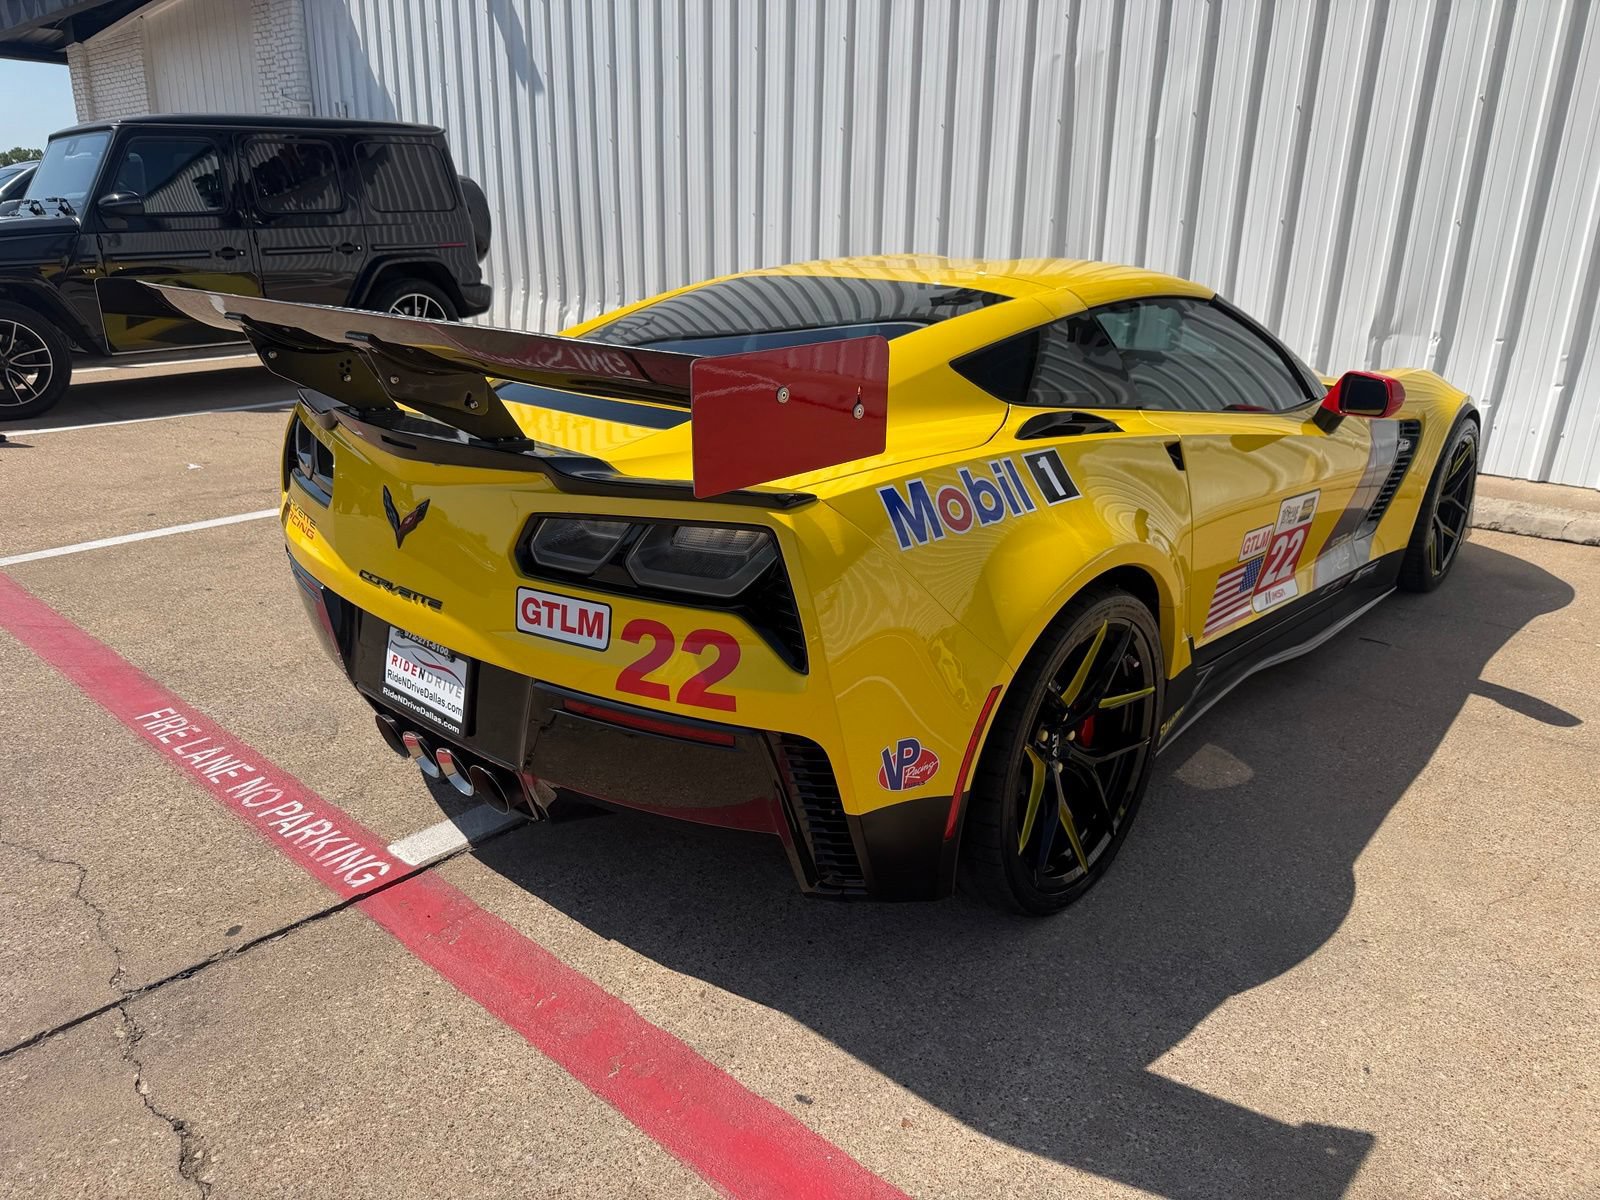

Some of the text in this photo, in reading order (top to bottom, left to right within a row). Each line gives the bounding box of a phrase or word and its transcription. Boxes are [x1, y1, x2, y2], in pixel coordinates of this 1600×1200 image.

[876, 457, 1038, 551] Mobil
[1242, 528, 1271, 556] GTLM
[1257, 527, 1305, 591] 22
[359, 569, 443, 611] CORVETTE
[521, 597, 605, 640] GTLM
[391, 654, 462, 700] RIDENDRIVE
[615, 618, 742, 712] 22
[382, 687, 460, 734] RideNDriveDallas.com
[387, 669, 462, 717] RideNDriveDallas.com
[880, 737, 922, 792] VP
[904, 760, 939, 785] Racing
[135, 706, 392, 889] FIRE LANE NO PARKING
